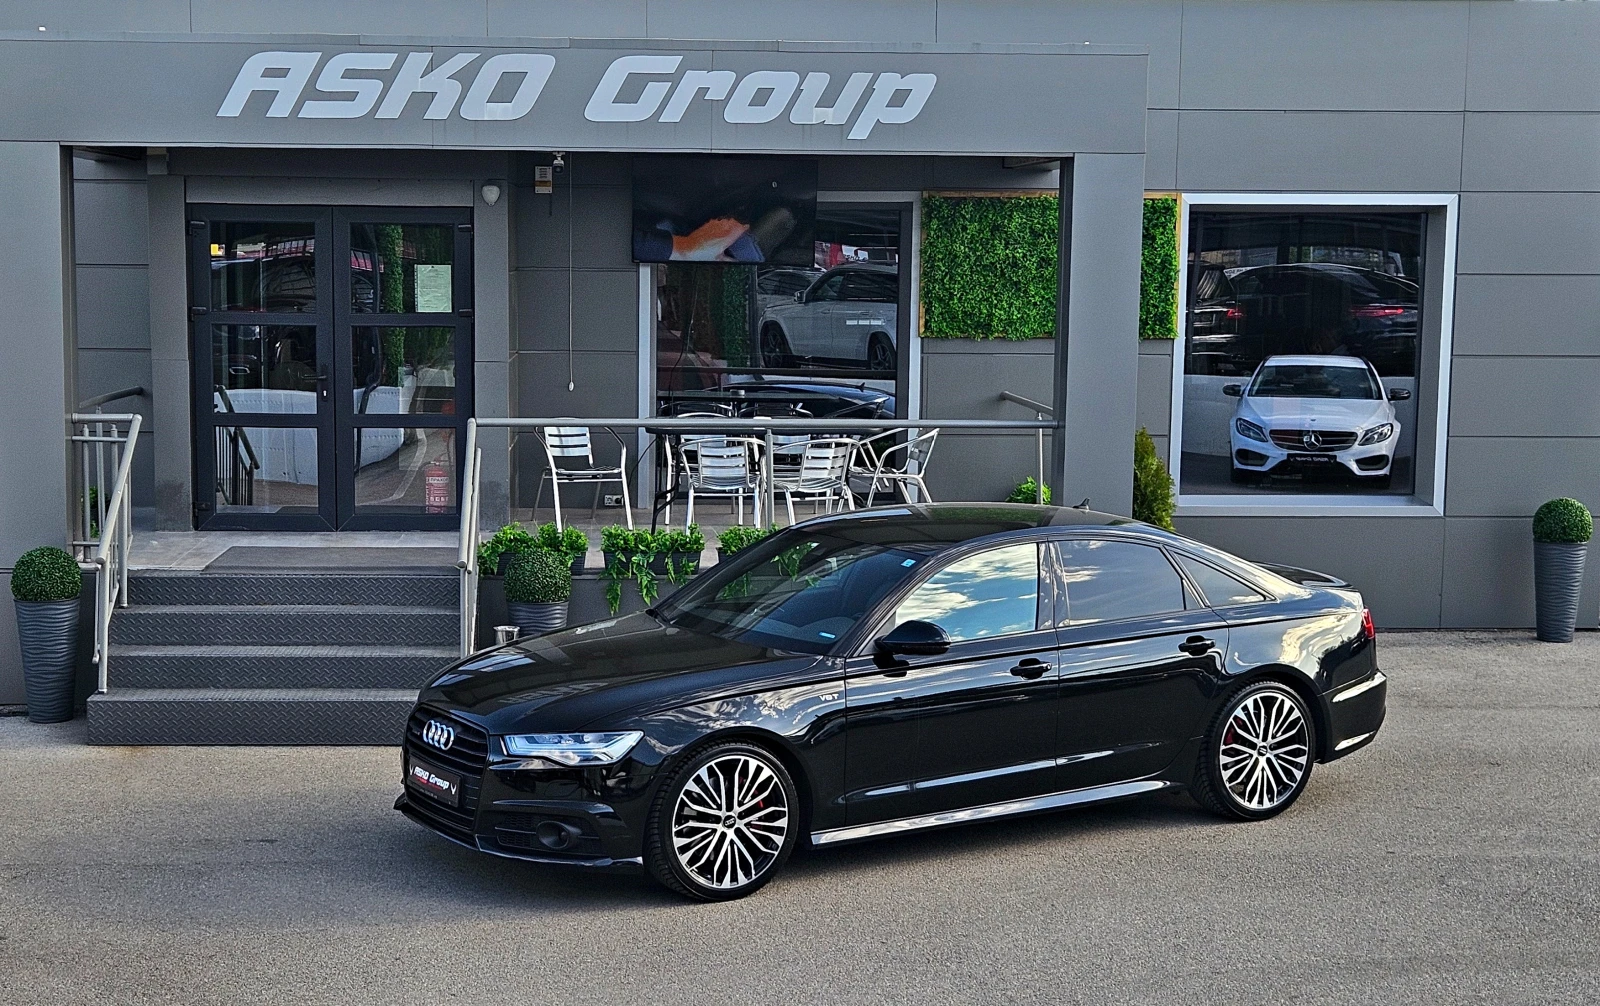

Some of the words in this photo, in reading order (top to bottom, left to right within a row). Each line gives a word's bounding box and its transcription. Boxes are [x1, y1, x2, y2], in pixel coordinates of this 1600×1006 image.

[216, 51, 556, 121] ASKO
[584, 55, 937, 139] Group
[414, 766, 429, 780] ASKO
[429, 773, 450, 790] Group
